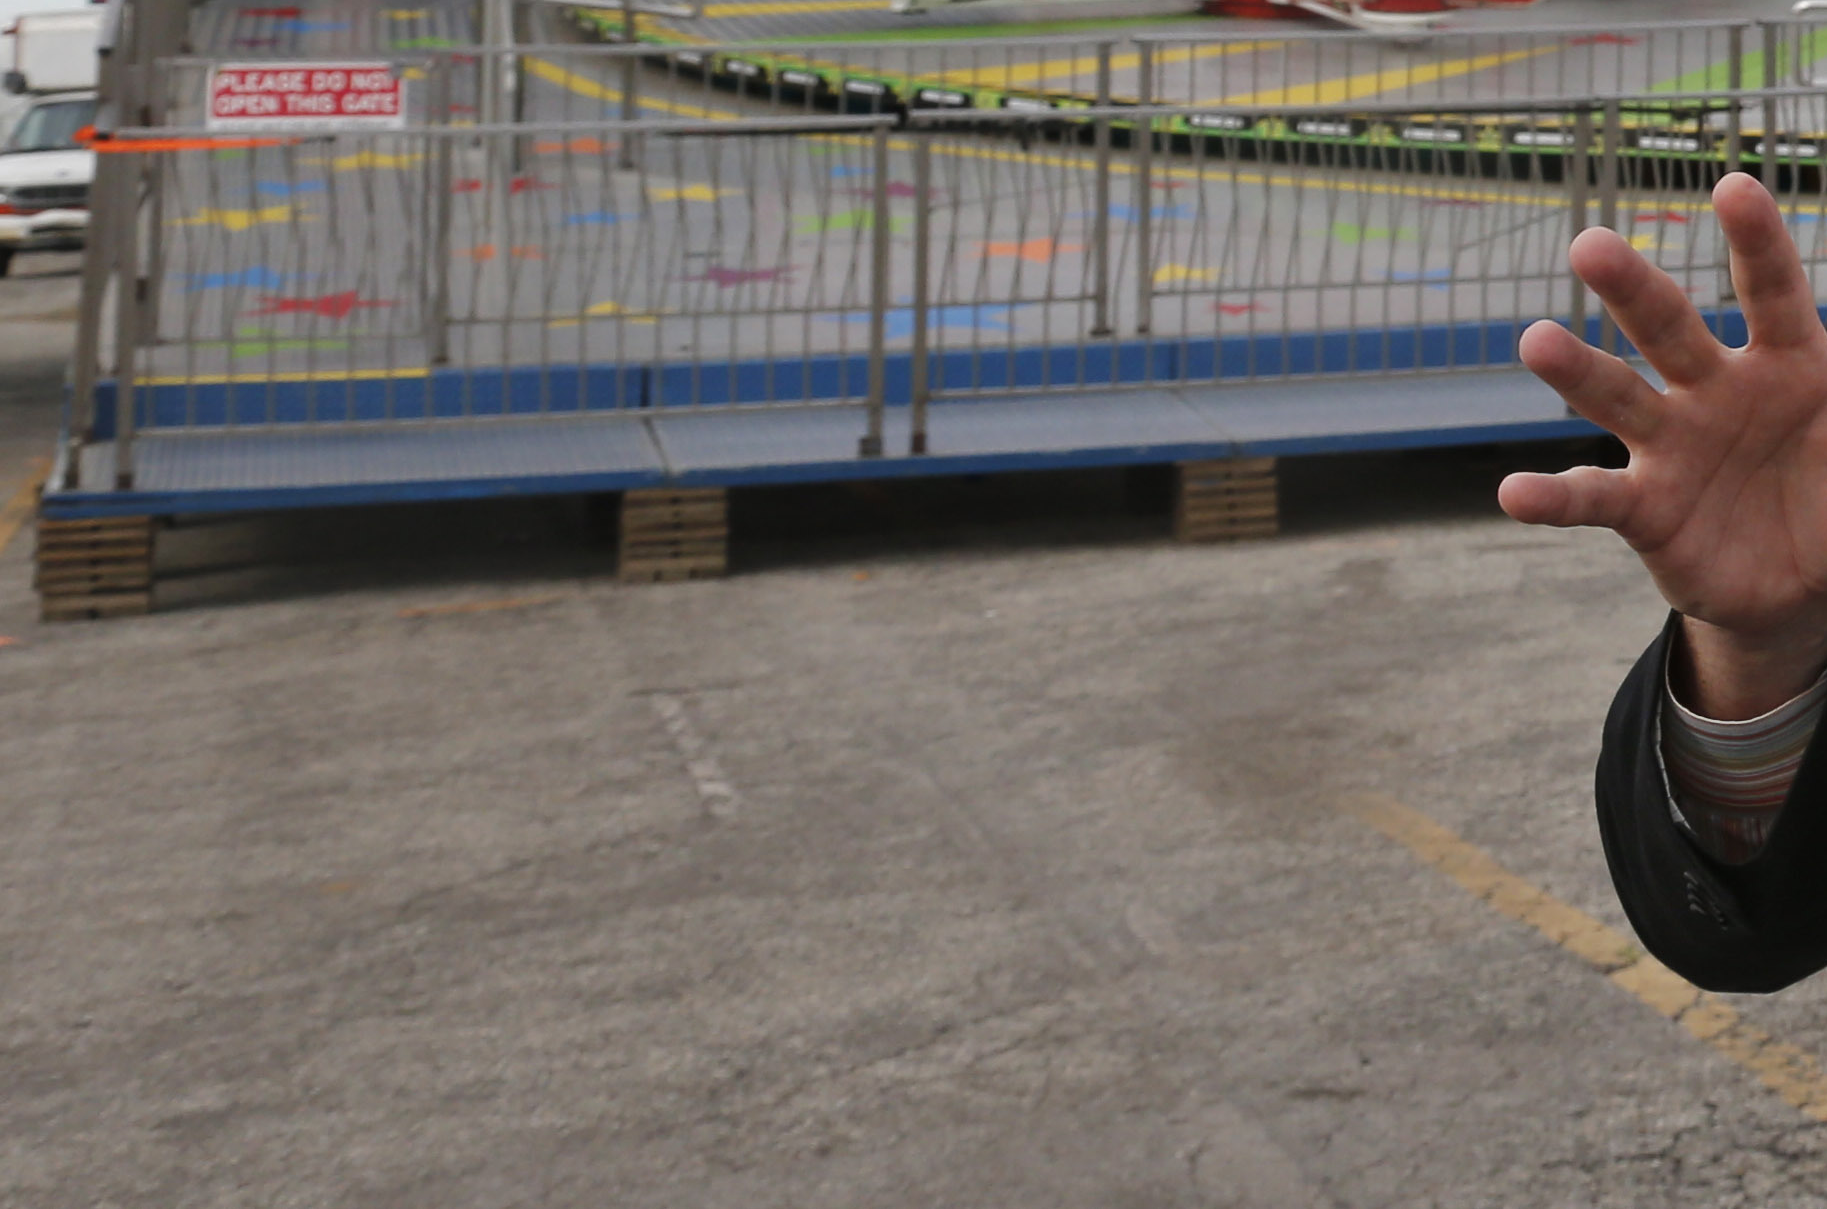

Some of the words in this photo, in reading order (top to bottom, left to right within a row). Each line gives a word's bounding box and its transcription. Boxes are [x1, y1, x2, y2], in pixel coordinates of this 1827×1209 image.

[215, 71, 308, 92] PLEASE
[311, 71, 348, 91] DO
[215, 94, 280, 114] OPEN
[284, 93, 337, 113] THIS
[341, 92, 396, 113] GATE
